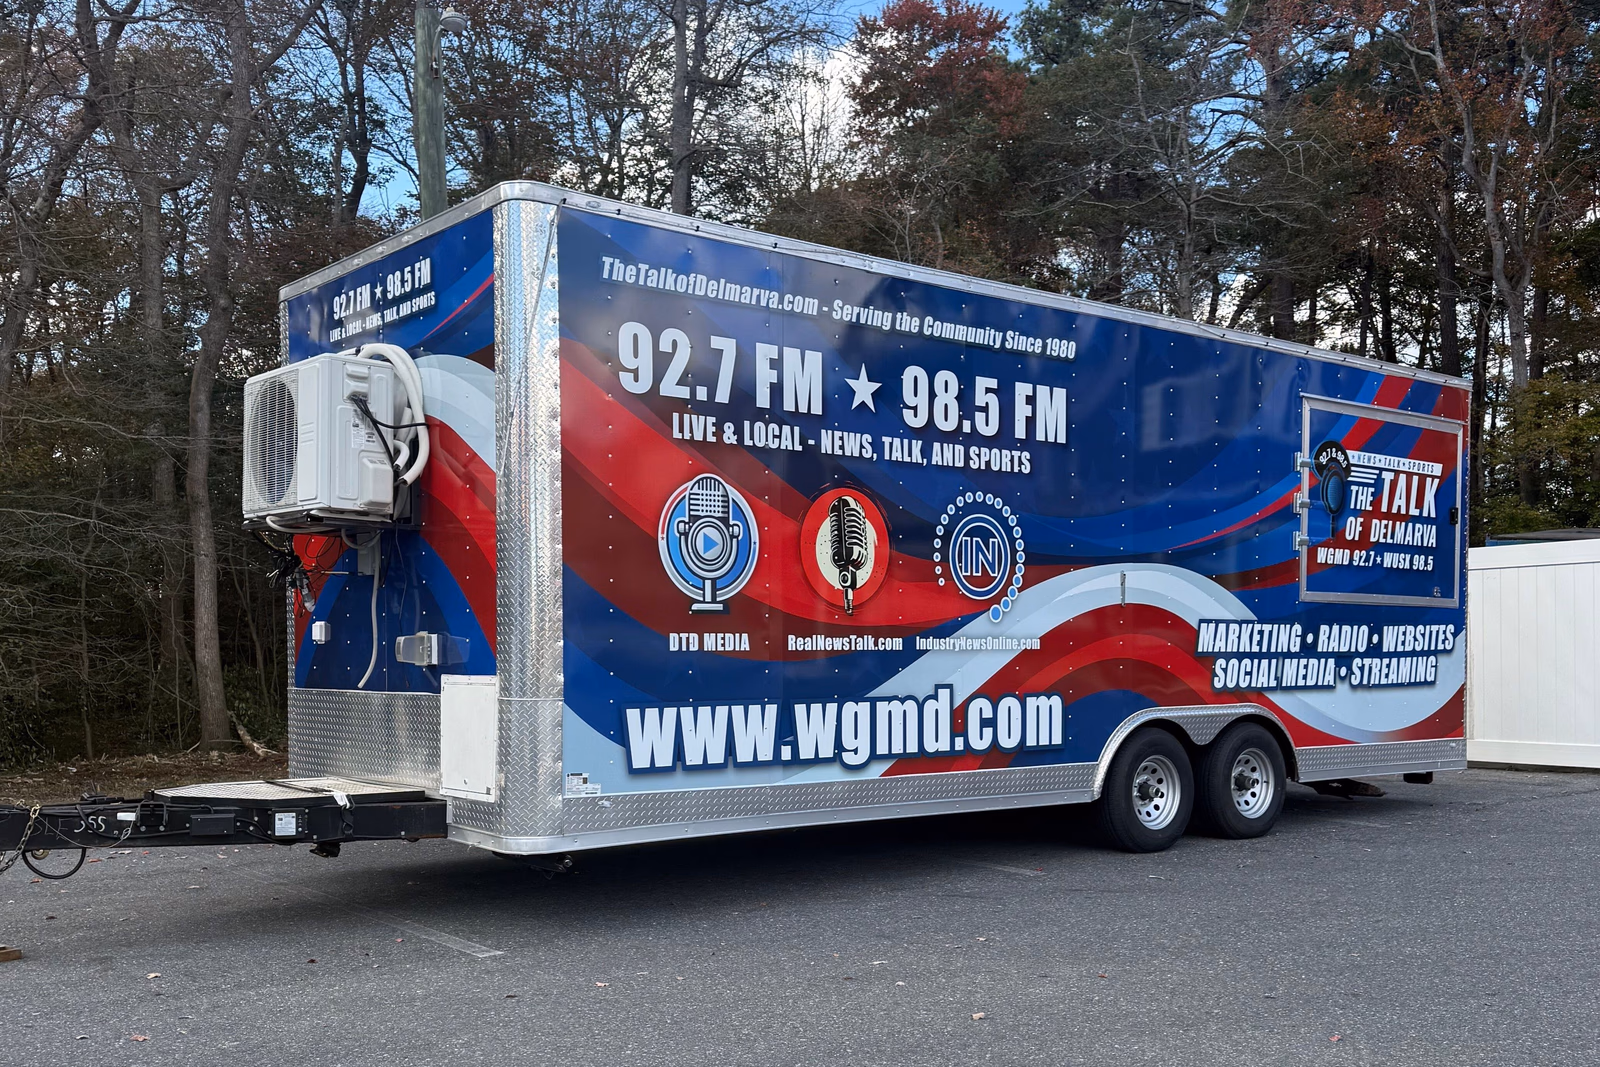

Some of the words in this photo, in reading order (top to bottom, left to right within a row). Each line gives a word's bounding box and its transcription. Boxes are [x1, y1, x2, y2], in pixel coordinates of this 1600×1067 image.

[333, 290, 354, 320] 92.7
[356, 283, 371, 312] FM
[386, 266, 412, 300] 98.5
[414, 257, 431, 289] FM
[329, 327, 341, 343] LIVE
[346, 320, 363, 337] LOCAL
[383, 306, 399, 323] TALK,
[399, 300, 411, 317] AND
[411, 291, 436, 312] SPORTS
[602, 256, 819, 316] TheTalkofDelmarva.com
[832, 299, 892, 331] Serving
[896, 311, 920, 334] the
[923, 315, 1003, 349] Community
[1005, 330, 1043, 354] Since
[1045, 337, 1077, 360] 1980
[618, 321, 737, 404] 92.7
[755, 342, 823, 415] FM
[902, 365, 1000, 437] 98.5
[1014, 381, 1067, 444] FM
[672, 412, 717, 443] LIVE
[723, 422, 738, 445] &
[743, 420, 803, 451] LOCAL
[820, 429, 878, 462] NEWS,
[881, 436, 927, 467] TALK,
[931, 442, 965, 468] AND
[969, 445, 1031, 474] SPORTS
[1356, 454, 1377, 465] NEWS
[1384, 457, 1401, 469] TALK
[1407, 460, 1435, 473] SPORTS
[1350, 485, 1375, 511] THE
[1381, 471, 1440, 518] TALK
[1345, 516, 1363, 541] OF
[1370, 519, 1437, 548] DELMARVA
[961, 536, 998, 577] IN
[1317, 547, 1350, 565] WGMD
[1352, 550, 1375, 567] 92.7
[1383, 552, 1411, 570] WUSX
[1412, 554, 1434, 572] 98.5
[669, 633, 699, 651] DTD
[703, 633, 750, 651] MEDIA
[787, 634, 903, 651] RealNewsTalk.com
[915, 635, 1041, 652] IndustryNewsOnline.com
[1197, 622, 1303, 653] MARKETING
[1317, 623, 1370, 653] RADIO
[1382, 623, 1455, 653] WEBSITES
[1213, 657, 1277, 689] SOCIAL
[1281, 657, 1336, 687] MEDIA
[1351, 656, 1437, 686] STREAMING
[625, 688, 1063, 769] www.wgmd.com
